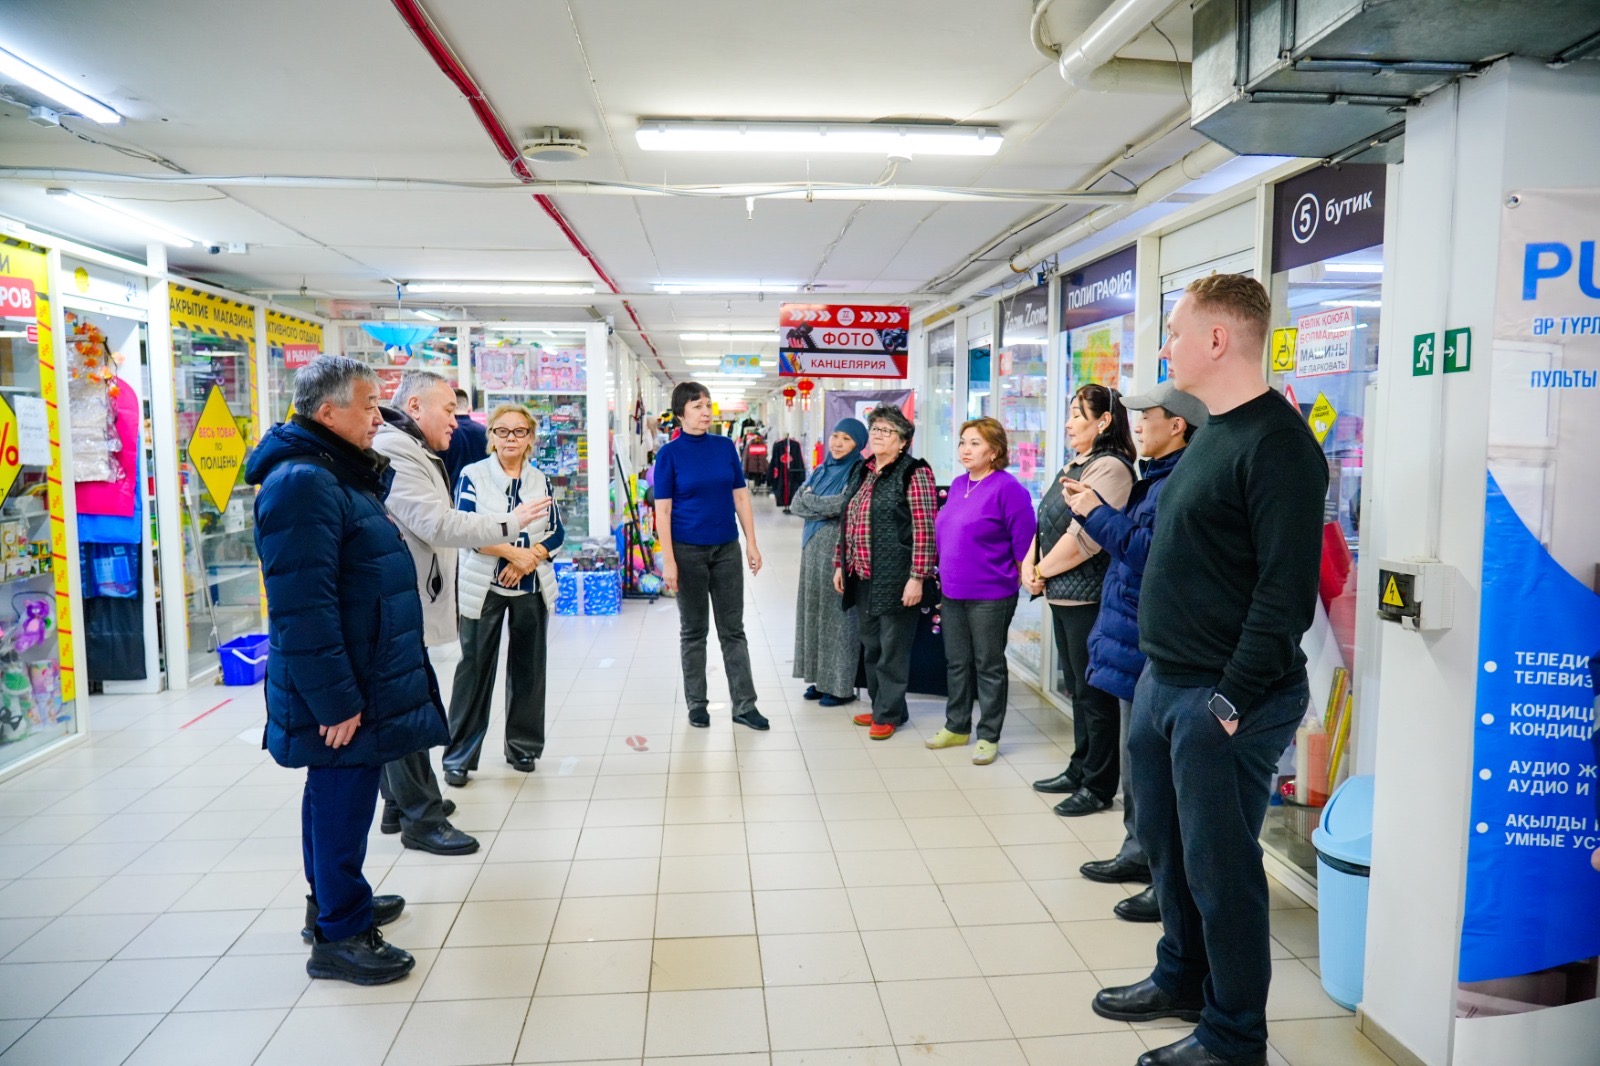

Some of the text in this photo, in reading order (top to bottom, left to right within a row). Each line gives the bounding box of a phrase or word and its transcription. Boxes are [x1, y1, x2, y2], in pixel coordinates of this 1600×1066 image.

[1299, 191, 1373, 233] 5 бутик
[1068, 269, 1132, 310] ПОЛИГРАФИЯ
[213, 307, 254, 330] МАГАЗИНА
[299, 329, 320, 345] ОТДЫХА
[822, 332, 875, 347] ФОТО
[1300, 342, 1348, 362] МАШИНЫ
[811, 358, 886, 370] КАНЦЕЛЯРИЯ
[1531, 369, 1598, 388] ПУЛЬТЫ
[199, 427, 236, 438] ВЕСЬ ТОВАР
[215, 442, 222, 451] ПО
[200, 456, 238, 470] ПОЛЦЕНЫ
[1513, 670, 1593, 688] ТЕЛЕВИЗ
[1508, 760, 1570, 777] АУДИО
[1507, 779, 1590, 796] АУДИО И
[1505, 813, 1587, 832] АҚЫЛДЫ
[1504, 832, 1565, 848] УМНЫЕ
